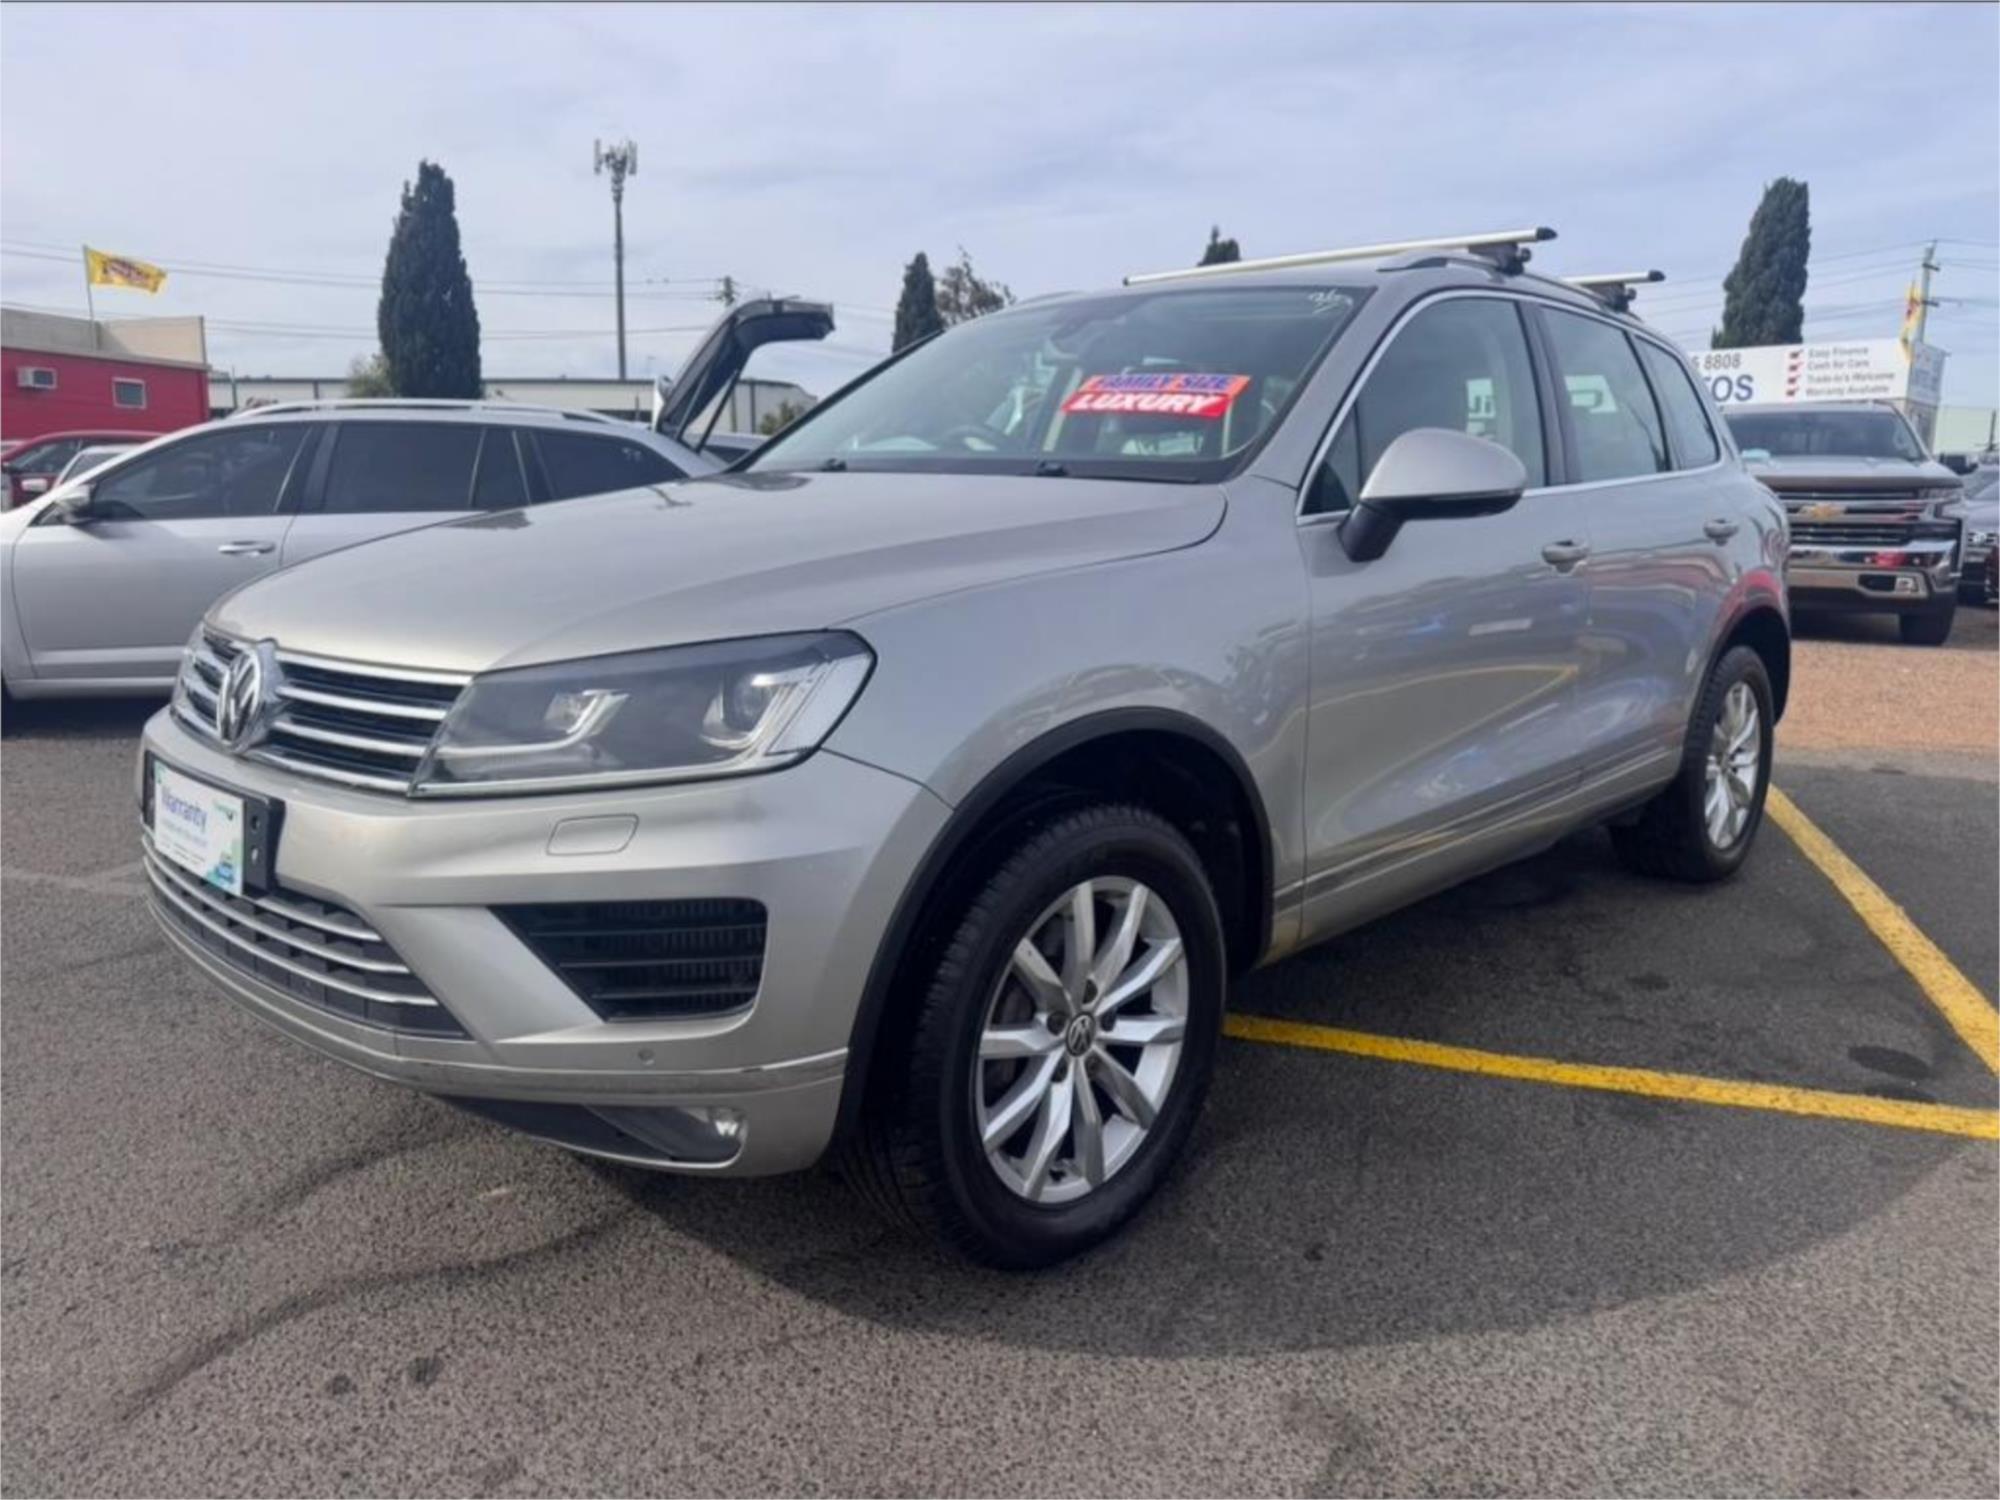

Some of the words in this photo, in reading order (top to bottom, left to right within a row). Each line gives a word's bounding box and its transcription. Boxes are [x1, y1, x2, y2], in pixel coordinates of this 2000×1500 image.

[1704, 352, 1741, 370] 8808
[1182, 376, 1232, 391] SIZE
[1702, 375, 1754, 402] OS
[1069, 393, 1224, 414] LUXURY
[161, 786, 207, 833] Warranty
